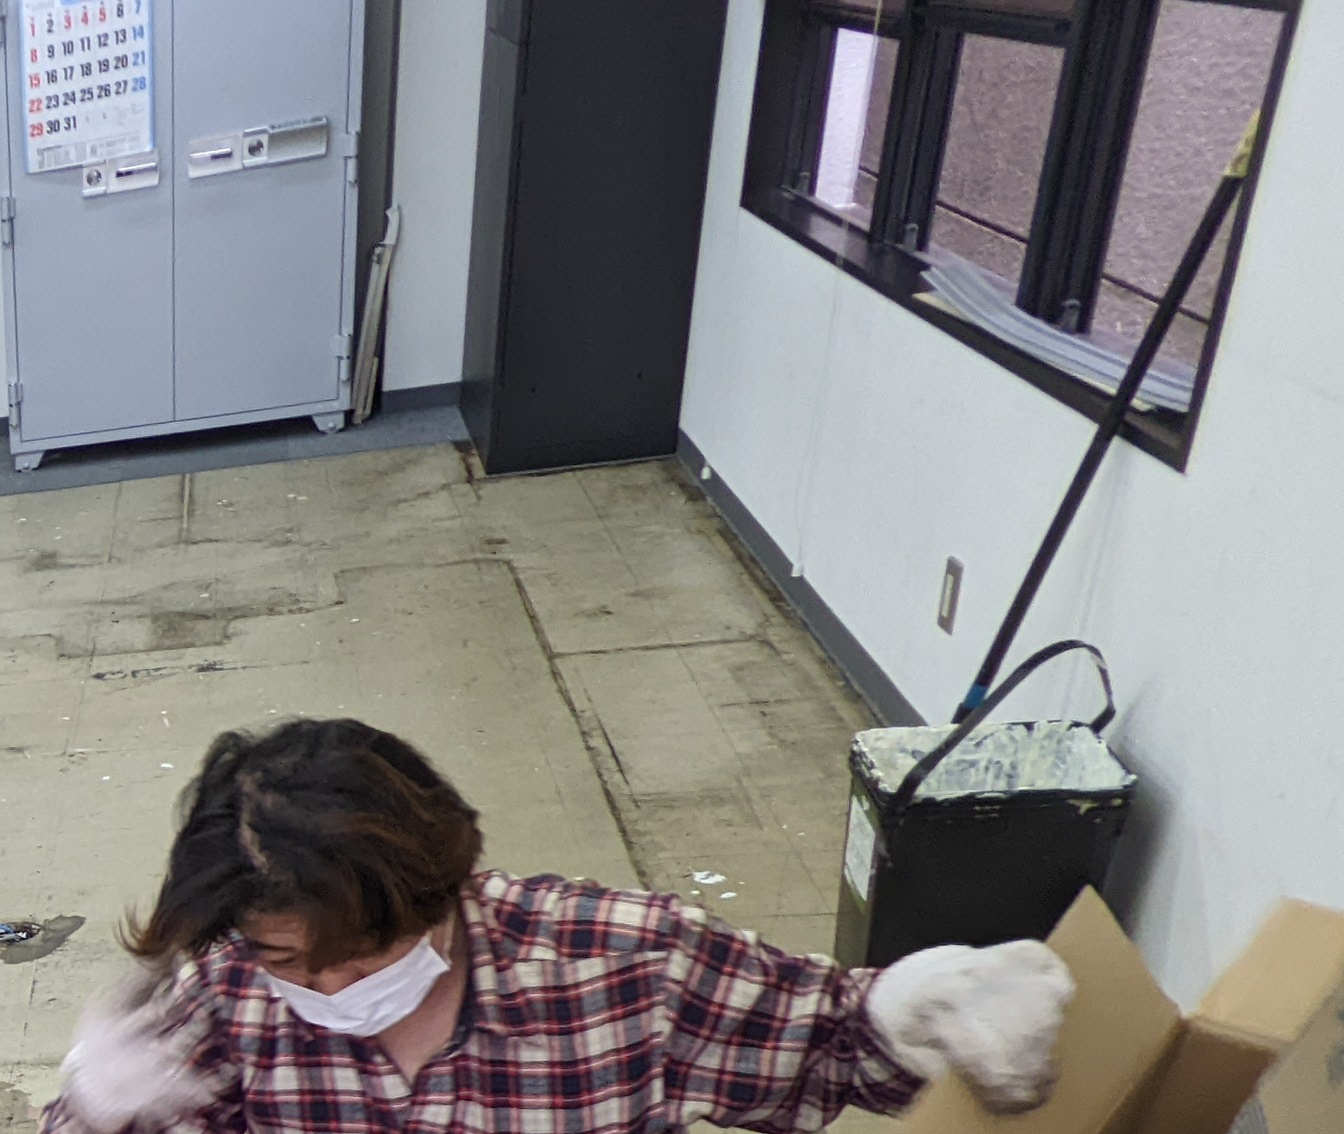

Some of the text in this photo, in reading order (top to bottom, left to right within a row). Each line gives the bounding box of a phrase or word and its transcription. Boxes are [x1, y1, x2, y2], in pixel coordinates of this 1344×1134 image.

[46, 19, 54, 33] 2
[64, 15, 71, 31] 3
[81, 11, 89, 25] 4
[99, 7, 106, 22] 5
[117, 3, 124, 18] 6
[135, 0, 142, 14] 7
[30, 25, 144, 63] 8 9 10 11 12 13 14
[29, 50, 145, 88] 15 16 17 18 19 20 21
[29, 76, 146, 113] 22 23 24 25 26 27 28
[29, 115, 77, 137] 29 30 31
